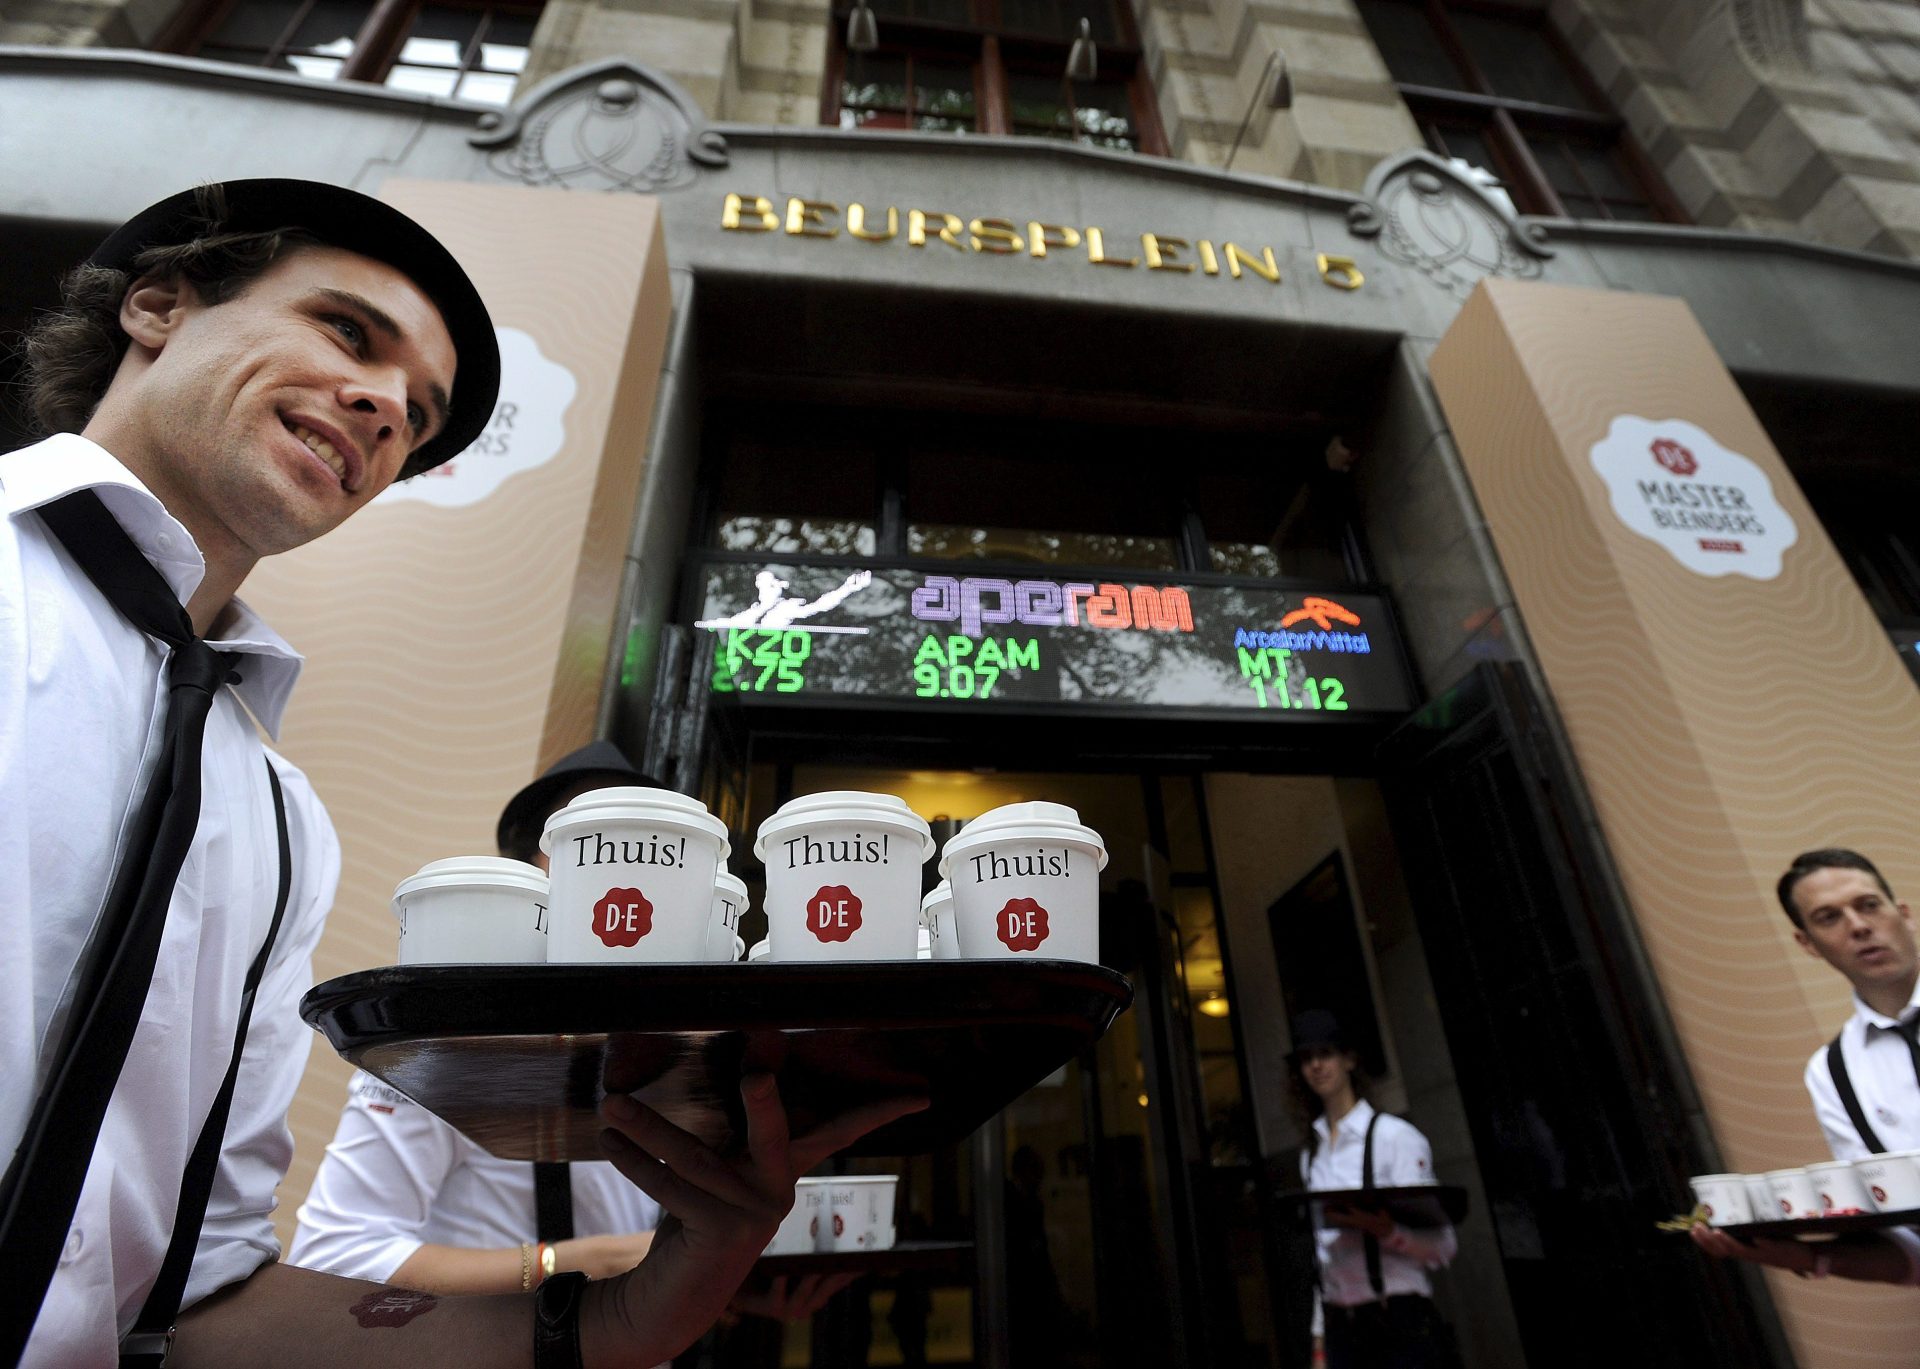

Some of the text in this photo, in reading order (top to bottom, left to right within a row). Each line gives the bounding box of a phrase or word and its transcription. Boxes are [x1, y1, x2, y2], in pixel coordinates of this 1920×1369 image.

[721, 192, 1365, 290] BEURSPLEIN 5
[1637, 478, 1753, 512] MASTER
[1651, 506, 1767, 536] BLENDERS
[914, 634, 1040, 671] APAM
[1238, 647, 1292, 680] MT
[913, 664, 1000, 699] 9.07
[1250, 676, 1349, 711] 11.12
[573, 832, 687, 869] Thuis!
[783, 833, 889, 870] Thuis!
[969, 848, 1071, 884] Thuis!
